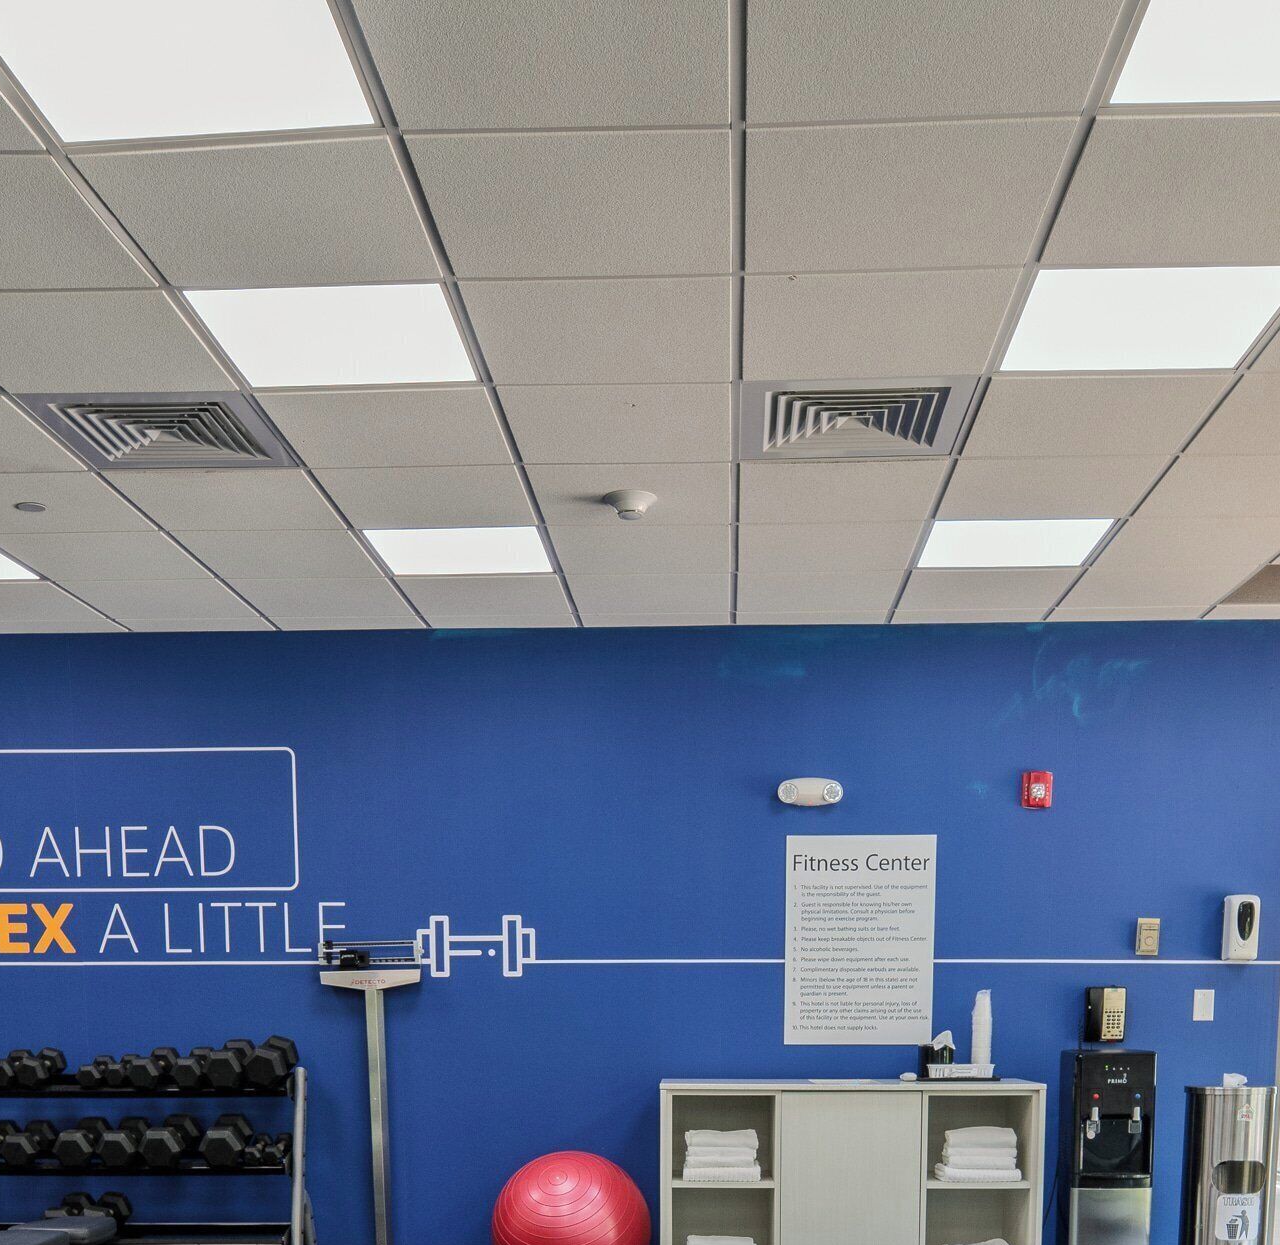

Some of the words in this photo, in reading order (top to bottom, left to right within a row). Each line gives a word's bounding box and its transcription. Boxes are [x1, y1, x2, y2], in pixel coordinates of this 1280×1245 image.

[29, 825, 236, 878] AHEAD
[793, 854, 859, 871] Fitness
[866, 853, 930, 871] Center
[812, 883, 829, 891] facility
[899, 883, 928, 891] equipment
[815, 890, 849, 898] responsibility
[822, 901, 851, 909] responsible
[859, 901, 882, 909] knowing
[800, 908, 822, 916] physical
[874, 908, 898, 916] physician
[800, 915, 827, 923] beginning
[98, 902, 139, 954] A
[164, 902, 346, 953] LITTLE
[837, 925, 857, 933] bathing
[817, 935, 830, 943] keep
[856, 935, 875, 943] objects
[817, 955, 830, 963] wipe
[845, 955, 874, 963] equipment
[800, 965, 839, 974] Complimentary
[839, 965, 866, 974] disposable
[799, 983, 826, 991] permitted
[841, 983, 870, 991] equipment
[891, 983, 908, 991] parent
[799, 990, 822, 998] guardian
[862, 1000, 885, 1008] personal
[870, 1007, 887, 1015] arising
[816, 1014, 832, 1022] facility
[846, 1024, 864, 1032] supply
